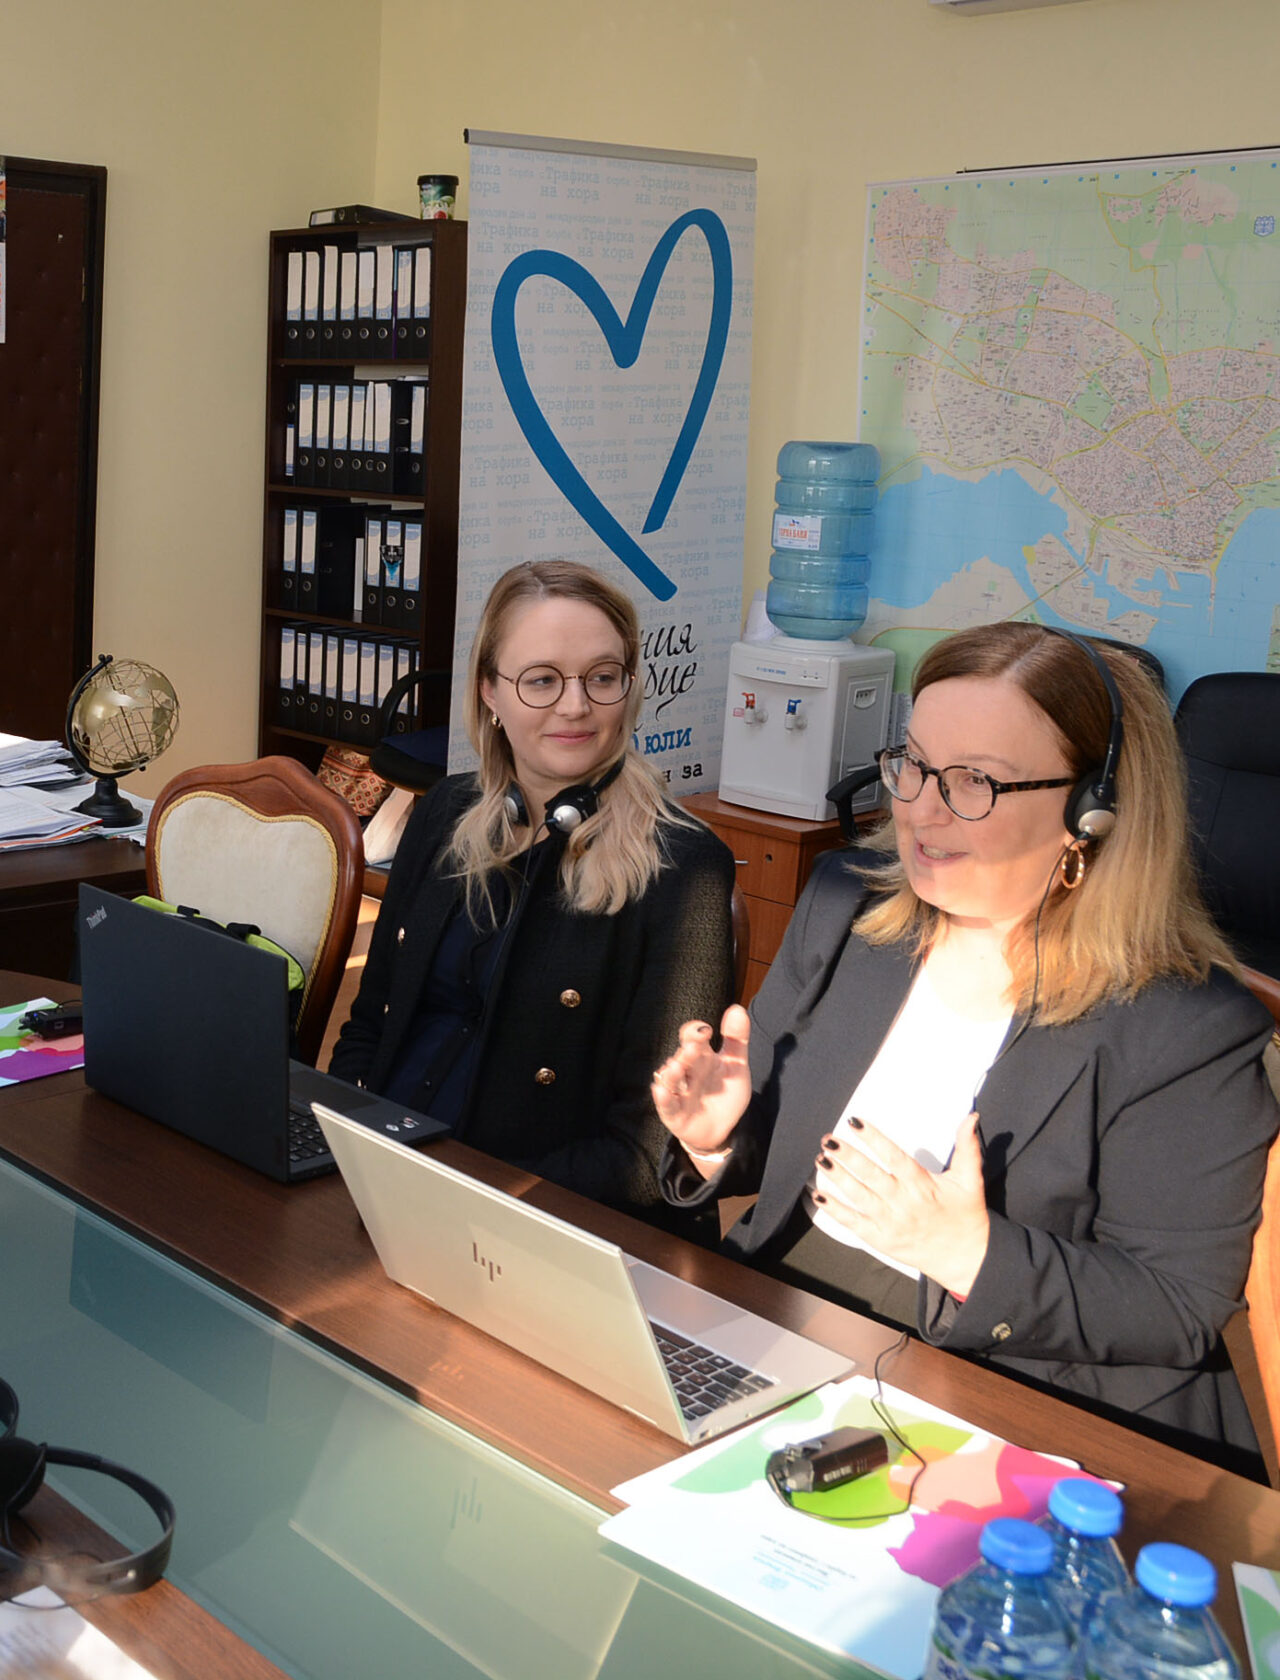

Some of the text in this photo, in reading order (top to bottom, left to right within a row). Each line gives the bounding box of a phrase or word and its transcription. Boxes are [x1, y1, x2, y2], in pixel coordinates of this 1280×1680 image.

[546, 166, 600, 184] Трафика
[640, 176, 690, 192] Трафика
[726, 183, 754, 198] Траф
[540, 185, 600, 204] на хора
[635, 192, 690, 210] на хора
[481, 222, 539, 239] Трафика
[582, 228, 634, 244] Трафика
[477, 240, 494, 253] на
[578, 246, 634, 262] на хора
[538, 302, 554, 314] на
[474, 360, 490, 372] на
[576, 360, 590, 370] на
[633, 396, 682, 411] Трафика
[561, 416, 595, 432] хора
[628, 414, 644, 424] на
[475, 456, 530, 473] Трафика
[470, 473, 530, 489] на хора
[598, 468, 628, 484] хора
[528, 528, 545, 540] на
[680, 566, 708, 580] хора
[640, 623, 697, 660] ния
[682, 763, 703, 779] за
[86, 904, 108, 930] ThinkPad
[471, 1241, 503, 1283] hp
